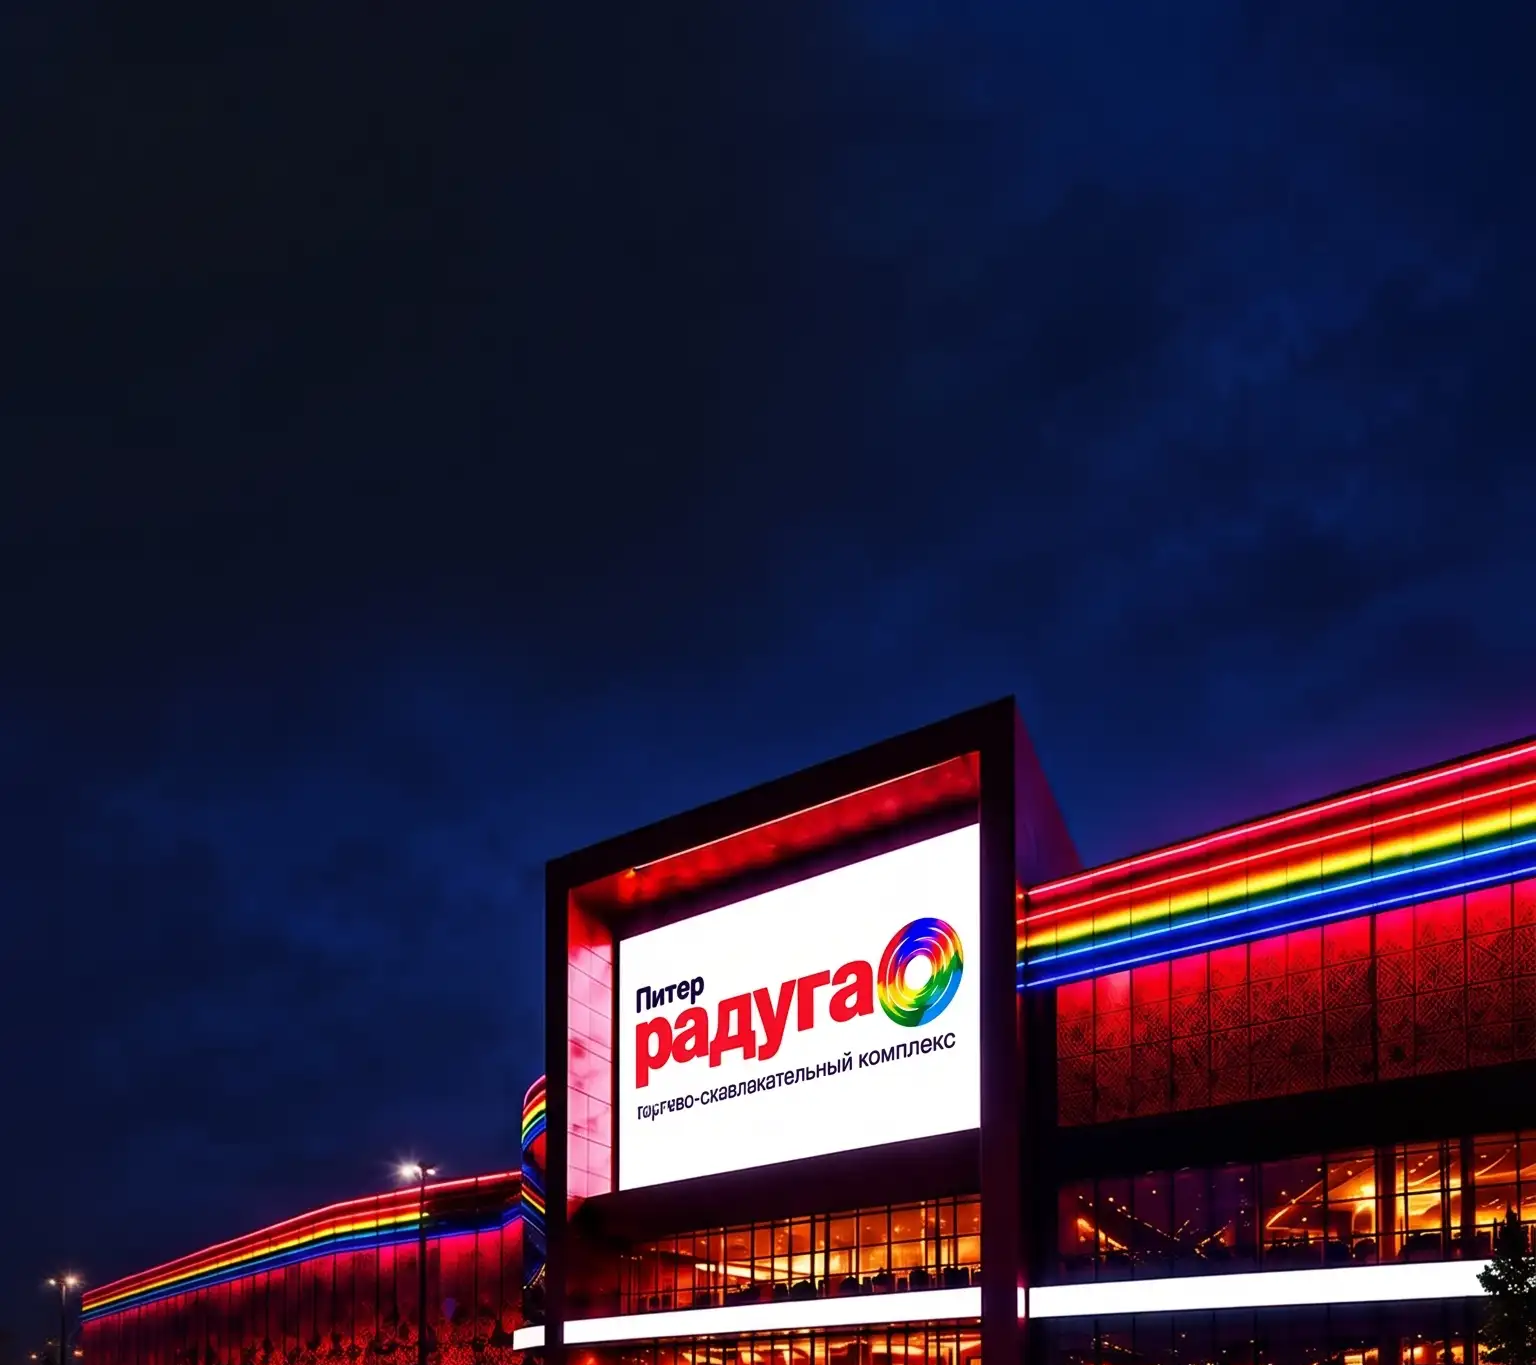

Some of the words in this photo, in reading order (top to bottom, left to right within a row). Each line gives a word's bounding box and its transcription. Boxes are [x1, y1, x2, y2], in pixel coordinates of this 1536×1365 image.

[636, 975, 705, 1014] Питер
[635, 959, 875, 1089] радуга
[858, 1032, 956, 1069] комплекс
